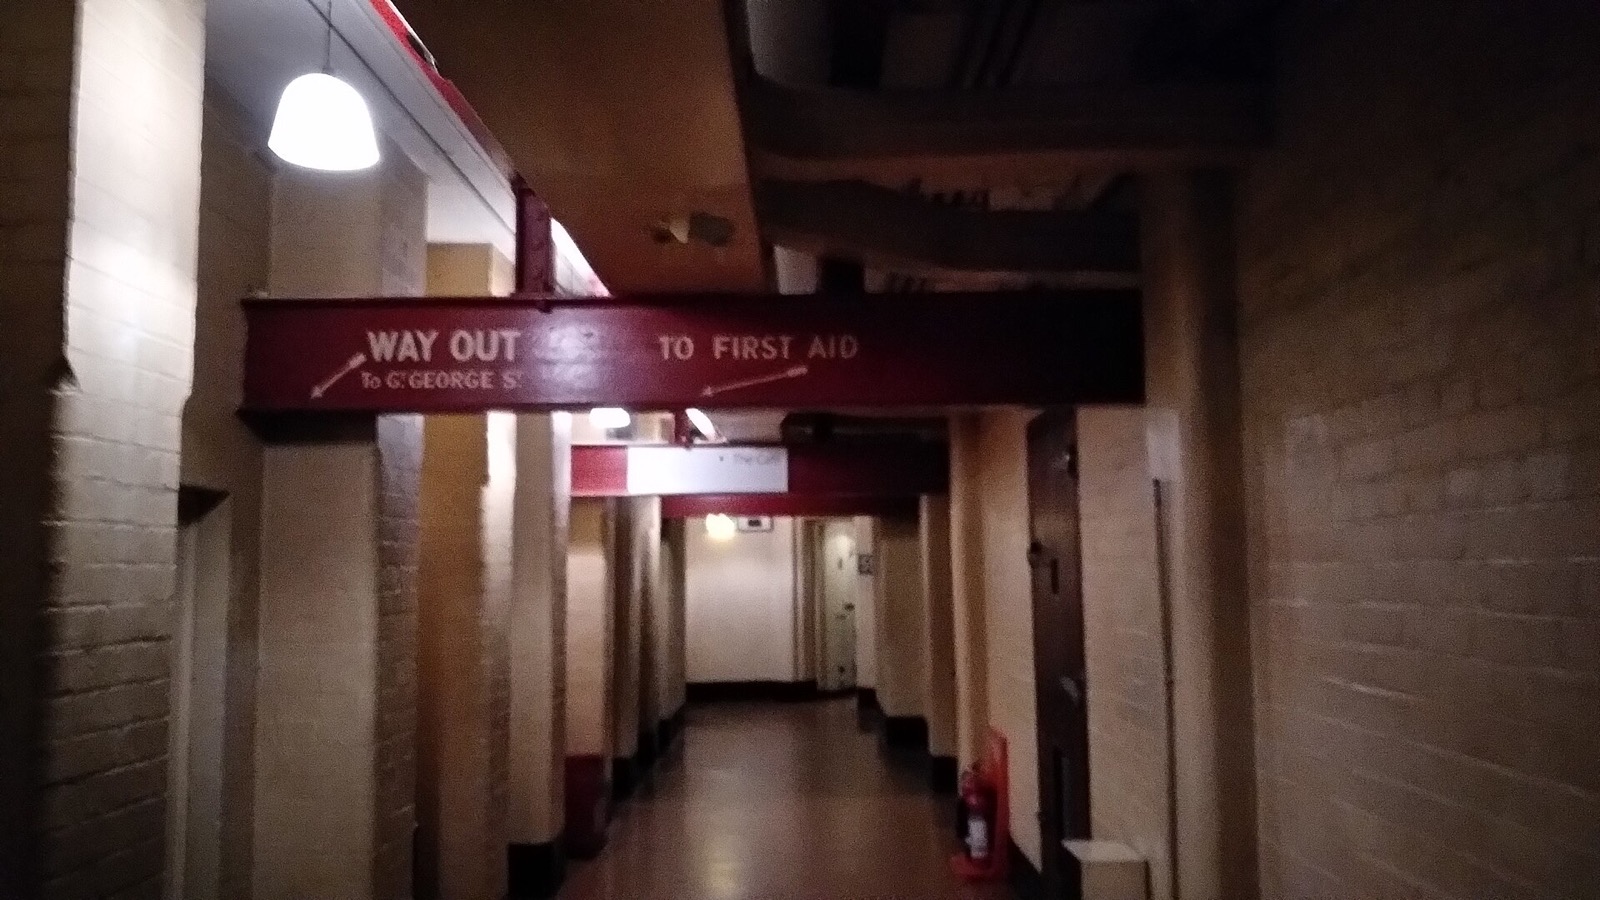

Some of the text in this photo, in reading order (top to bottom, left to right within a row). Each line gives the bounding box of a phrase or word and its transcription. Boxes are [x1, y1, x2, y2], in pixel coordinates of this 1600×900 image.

[367, 329, 521, 362] WAY OUT
[659, 334, 858, 360] TO FIRST AID
[408, 370, 494, 389] GEORGE
